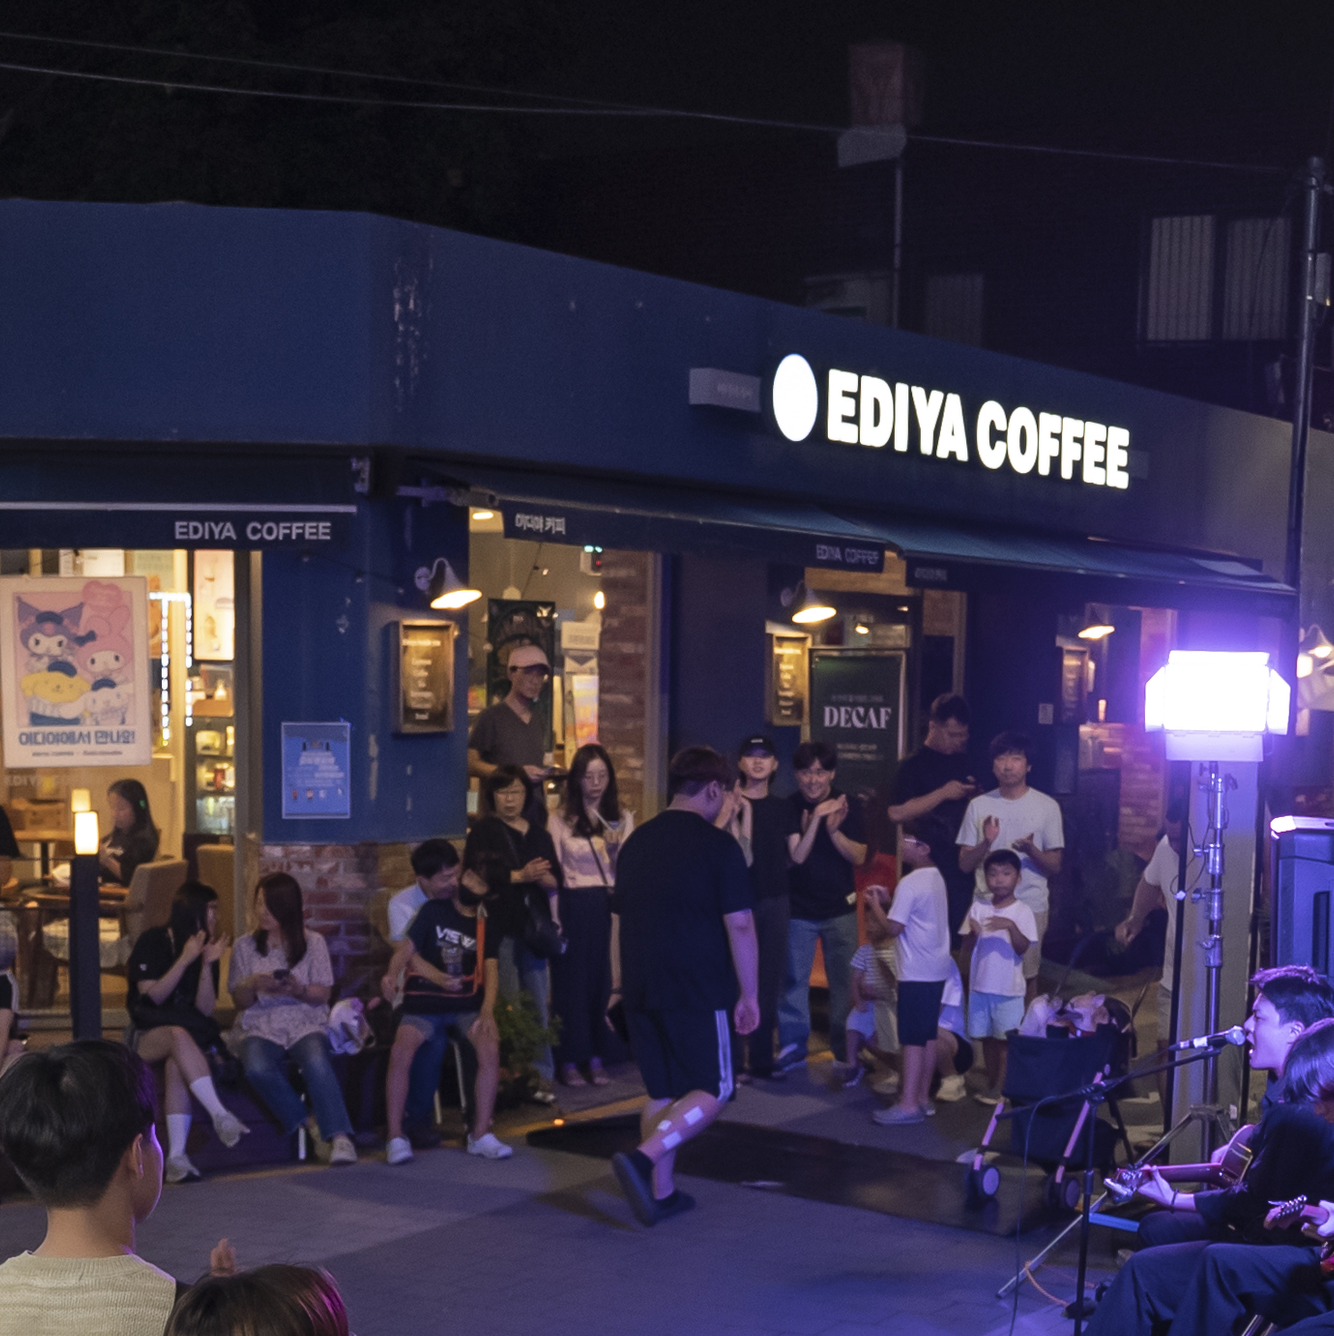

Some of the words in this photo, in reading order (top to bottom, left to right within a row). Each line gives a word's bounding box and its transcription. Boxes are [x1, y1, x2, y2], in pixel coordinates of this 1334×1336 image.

[827, 368, 968, 462] EDIYA
[976, 400, 1130, 490] COFFEE
[174, 521, 237, 540] EDIYA
[246, 522, 331, 541] COFFEE
[844, 546, 880, 565] COFFEE
[823, 705, 892, 730] DECAF
[18, 730, 91, 746] 이디야에서
